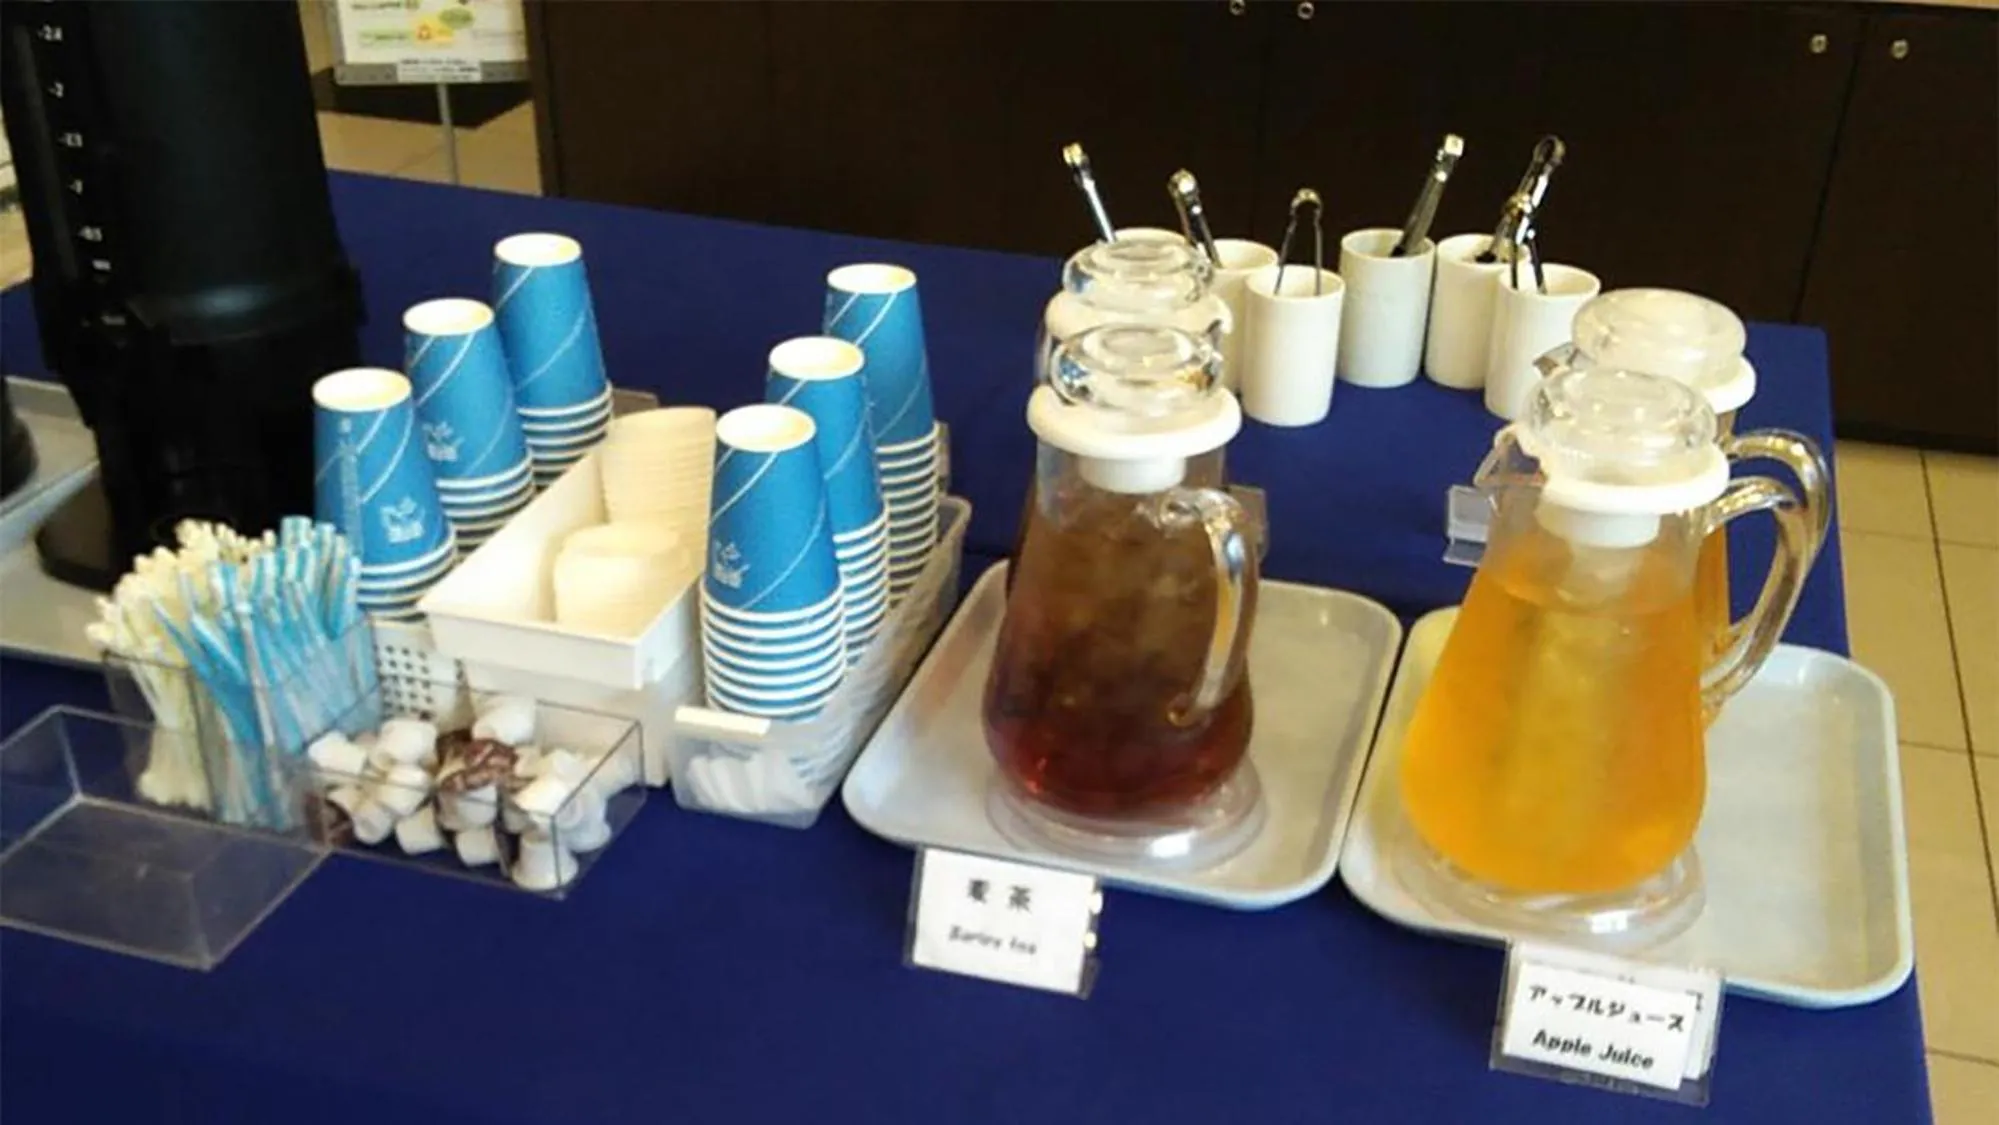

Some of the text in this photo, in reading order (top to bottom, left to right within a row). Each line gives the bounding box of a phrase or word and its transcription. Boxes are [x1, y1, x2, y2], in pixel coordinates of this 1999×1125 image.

[1530, 986, 1684, 1031] アップルジュース
[1533, 1029, 1655, 1069] Apple Juice
